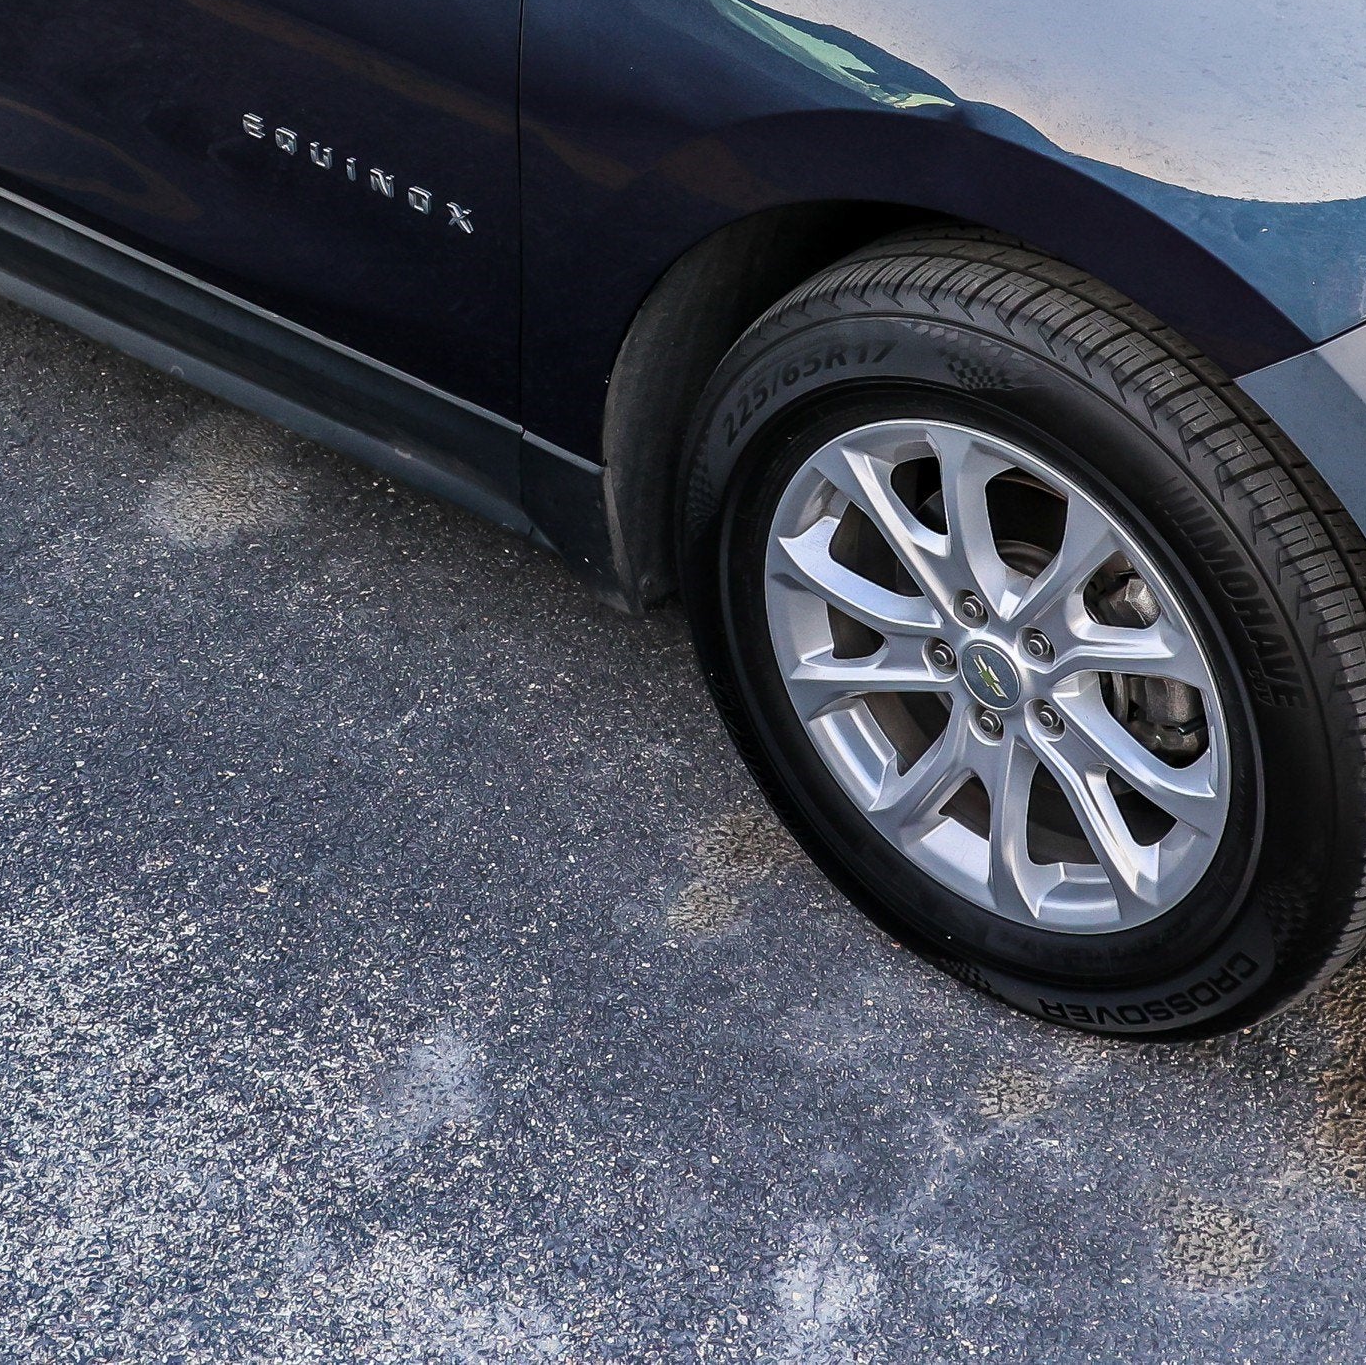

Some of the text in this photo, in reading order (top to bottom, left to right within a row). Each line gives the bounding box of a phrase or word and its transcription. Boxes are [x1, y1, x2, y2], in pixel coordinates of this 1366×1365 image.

[241, 112, 475, 235] EQUINOX
[722, 340, 899, 447] 225/65R17
[1187, 527, 1309, 708] MOHAVE
[1037, 950, 1260, 1026] CROSSOVER
